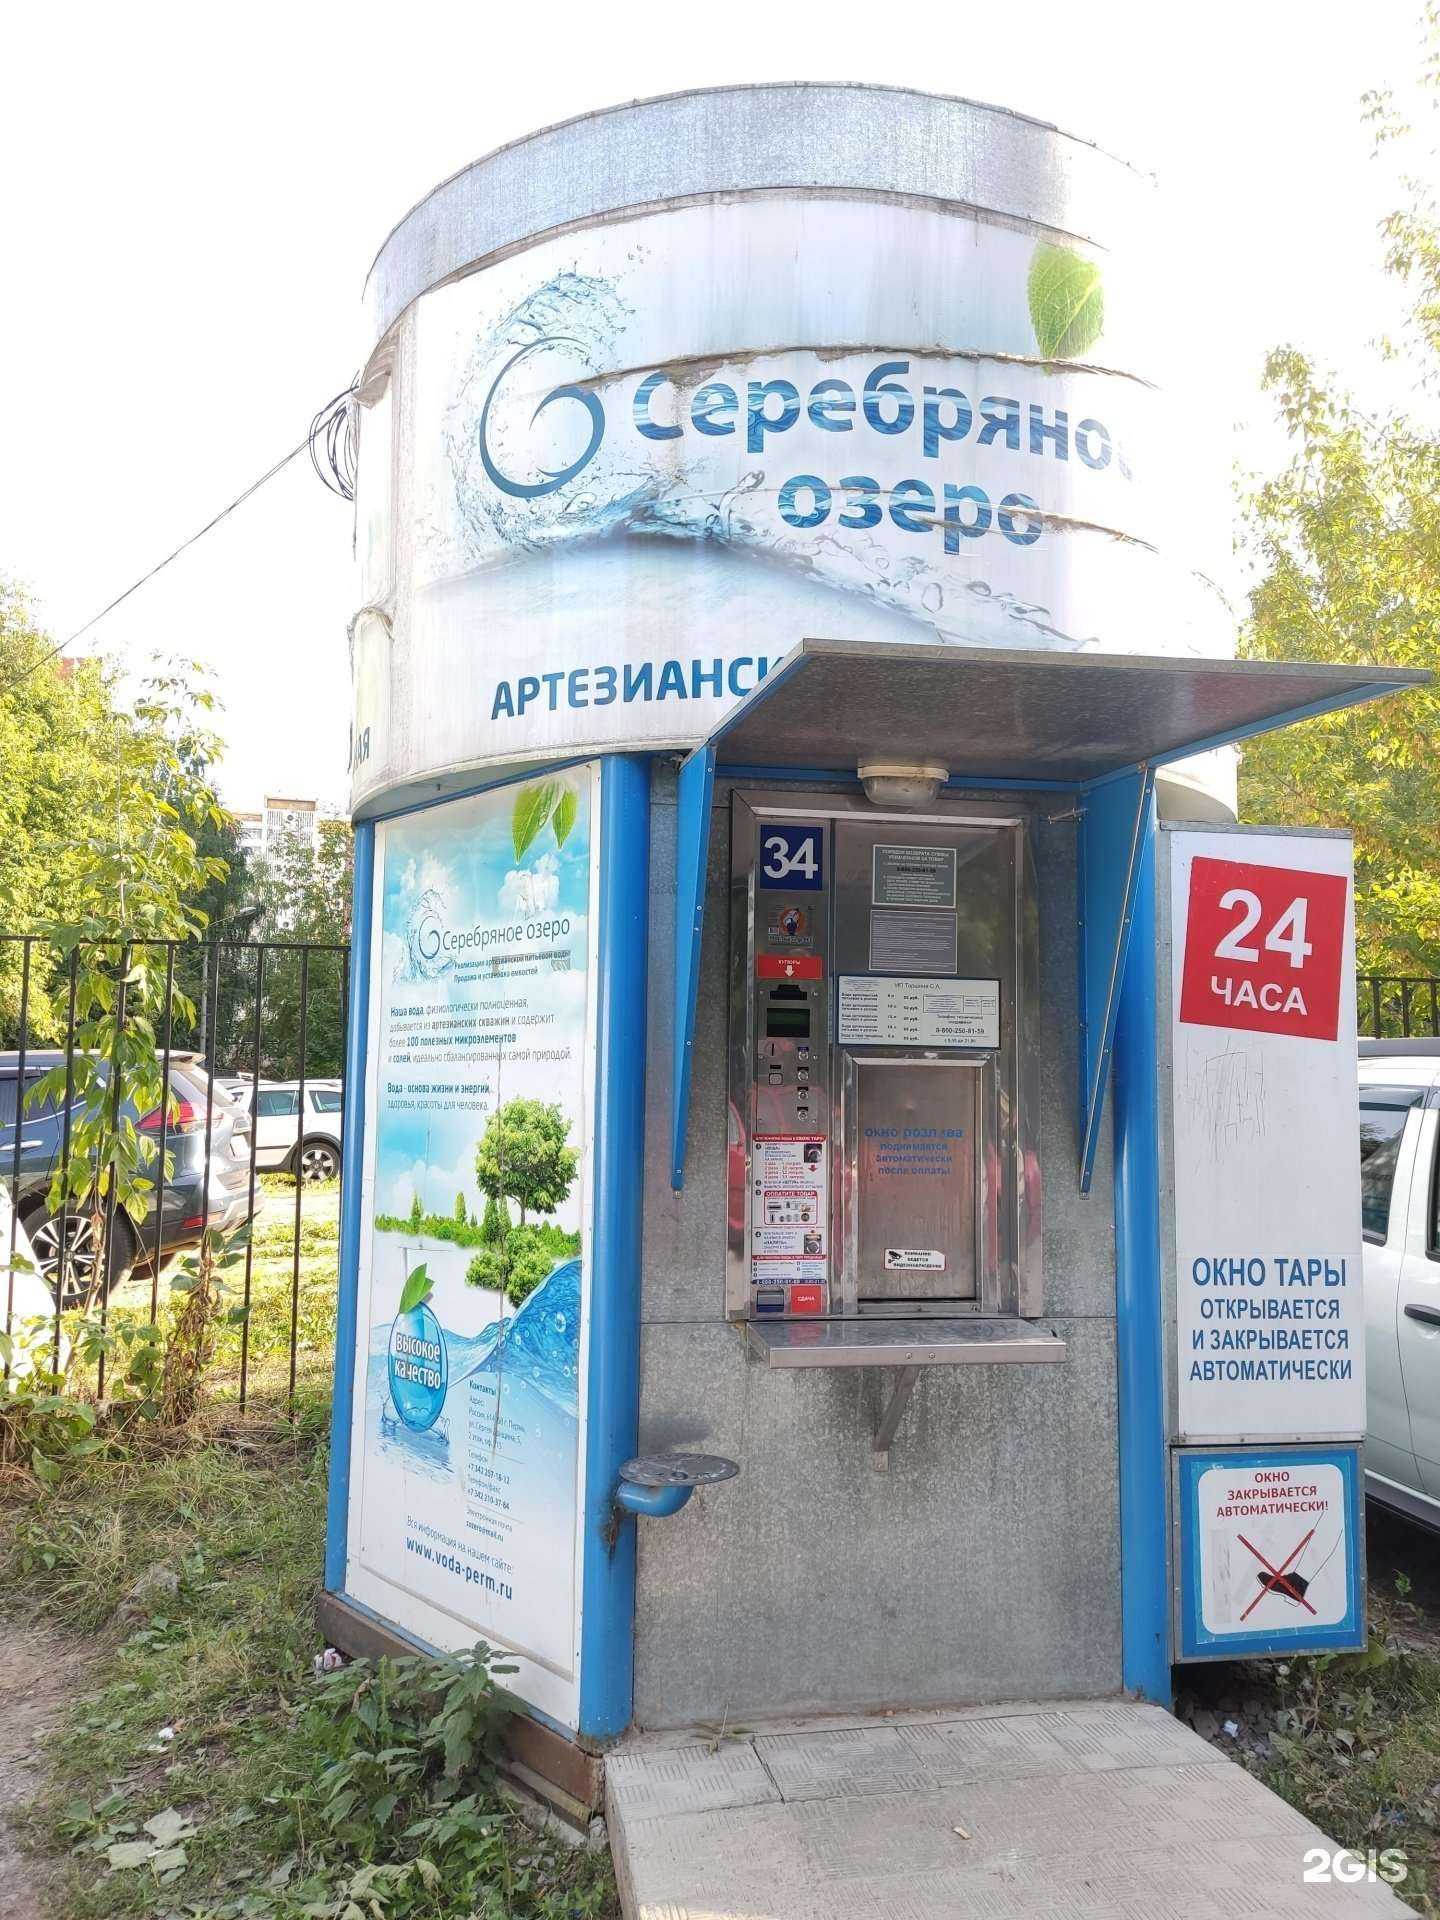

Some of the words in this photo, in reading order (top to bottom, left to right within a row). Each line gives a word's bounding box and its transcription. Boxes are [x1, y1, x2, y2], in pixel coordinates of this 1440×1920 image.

[778, 472, 1043, 555] озеро
[763, 836, 818, 880] 34
[442, 925, 523, 954] Серебряное
[526, 918, 570, 942] озеро
[1214, 888, 1313, 969] 24
[1210, 975, 1307, 1016] ЧАСА
[390, 1006, 407, 1017] Наша
[426, 1001, 479, 1016] физиологически
[431, 1018, 477, 1032] артезианских
[478, 1016, 510, 1027] скважин
[511, 1015, 516, 1025] и
[517, 1013, 555, 1027] содержит
[388, 1038, 406, 1048] более
[407, 1036, 419, 1047] 100
[419, 1034, 453, 1047] полезных
[454, 1032, 517, 1048] микроэлементов
[412, 1053, 442, 1065] идеально
[443, 1050, 507, 1064] сбалансированных
[508, 1048, 531, 1061] самой
[387, 1082, 403, 1094] Вода
[407, 1083, 430, 1094] основа
[430, 1083, 453, 1094] жизни
[454, 1084, 460, 1094] и
[416, 1100, 443, 1111] красоты
[443, 1100, 456, 1110] для
[864, 1128, 897, 1138] окно
[1191, 1259, 1266, 1287] ОКНО
[1274, 1258, 1347, 1286] ТАРЫ
[1200, 1299, 1340, 1320] ОТКРЫВАЕТСЯ
[395, 1333, 441, 1362] высокое
[1191, 1331, 1203, 1350] И
[1210, 1329, 1349, 1350] ЗАКРЫВАЕТСЯ
[394, 1359, 441, 1390] качество
[1190, 1359, 1352, 1381] АВТОМАТИЧЕСКИ
[1254, 1471, 1290, 1483] ОКНО
[1227, 1485, 1318, 1501] ЗАКРЫВАЕТСЯ
[1216, 1500, 1329, 1518] АВТОМАТИЧЕСКИ!
[407, 1515, 418, 1530] Вся
[418, 1525, 457, 1549] информация
[457, 1542, 467, 1553] на
[467, 1548, 490, 1564] нашем
[406, 1536, 513, 1601] www.voda-perm.ru
